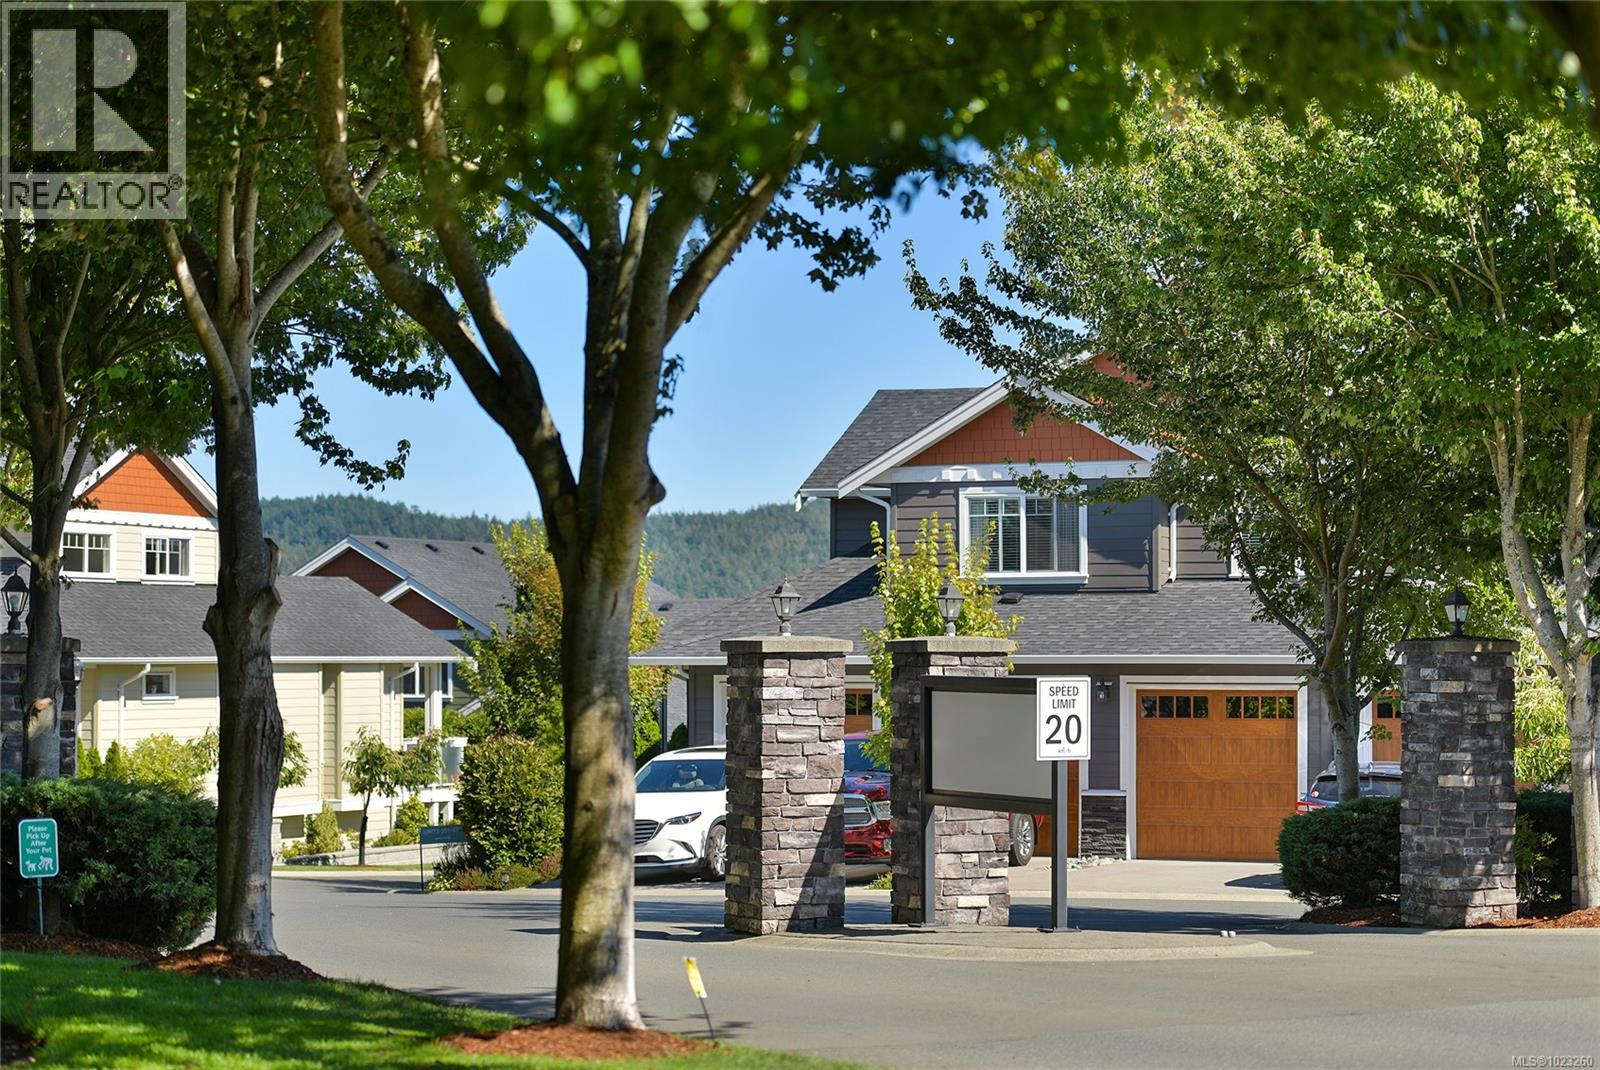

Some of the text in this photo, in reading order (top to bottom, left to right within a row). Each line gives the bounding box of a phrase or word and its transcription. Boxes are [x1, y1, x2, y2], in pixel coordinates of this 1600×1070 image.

[1049, 686, 1079, 696] SPEED
[1052, 699, 1077, 709] LIMIT
[1046, 714, 1081, 744] 20
[40, 832, 50, 840] Up
